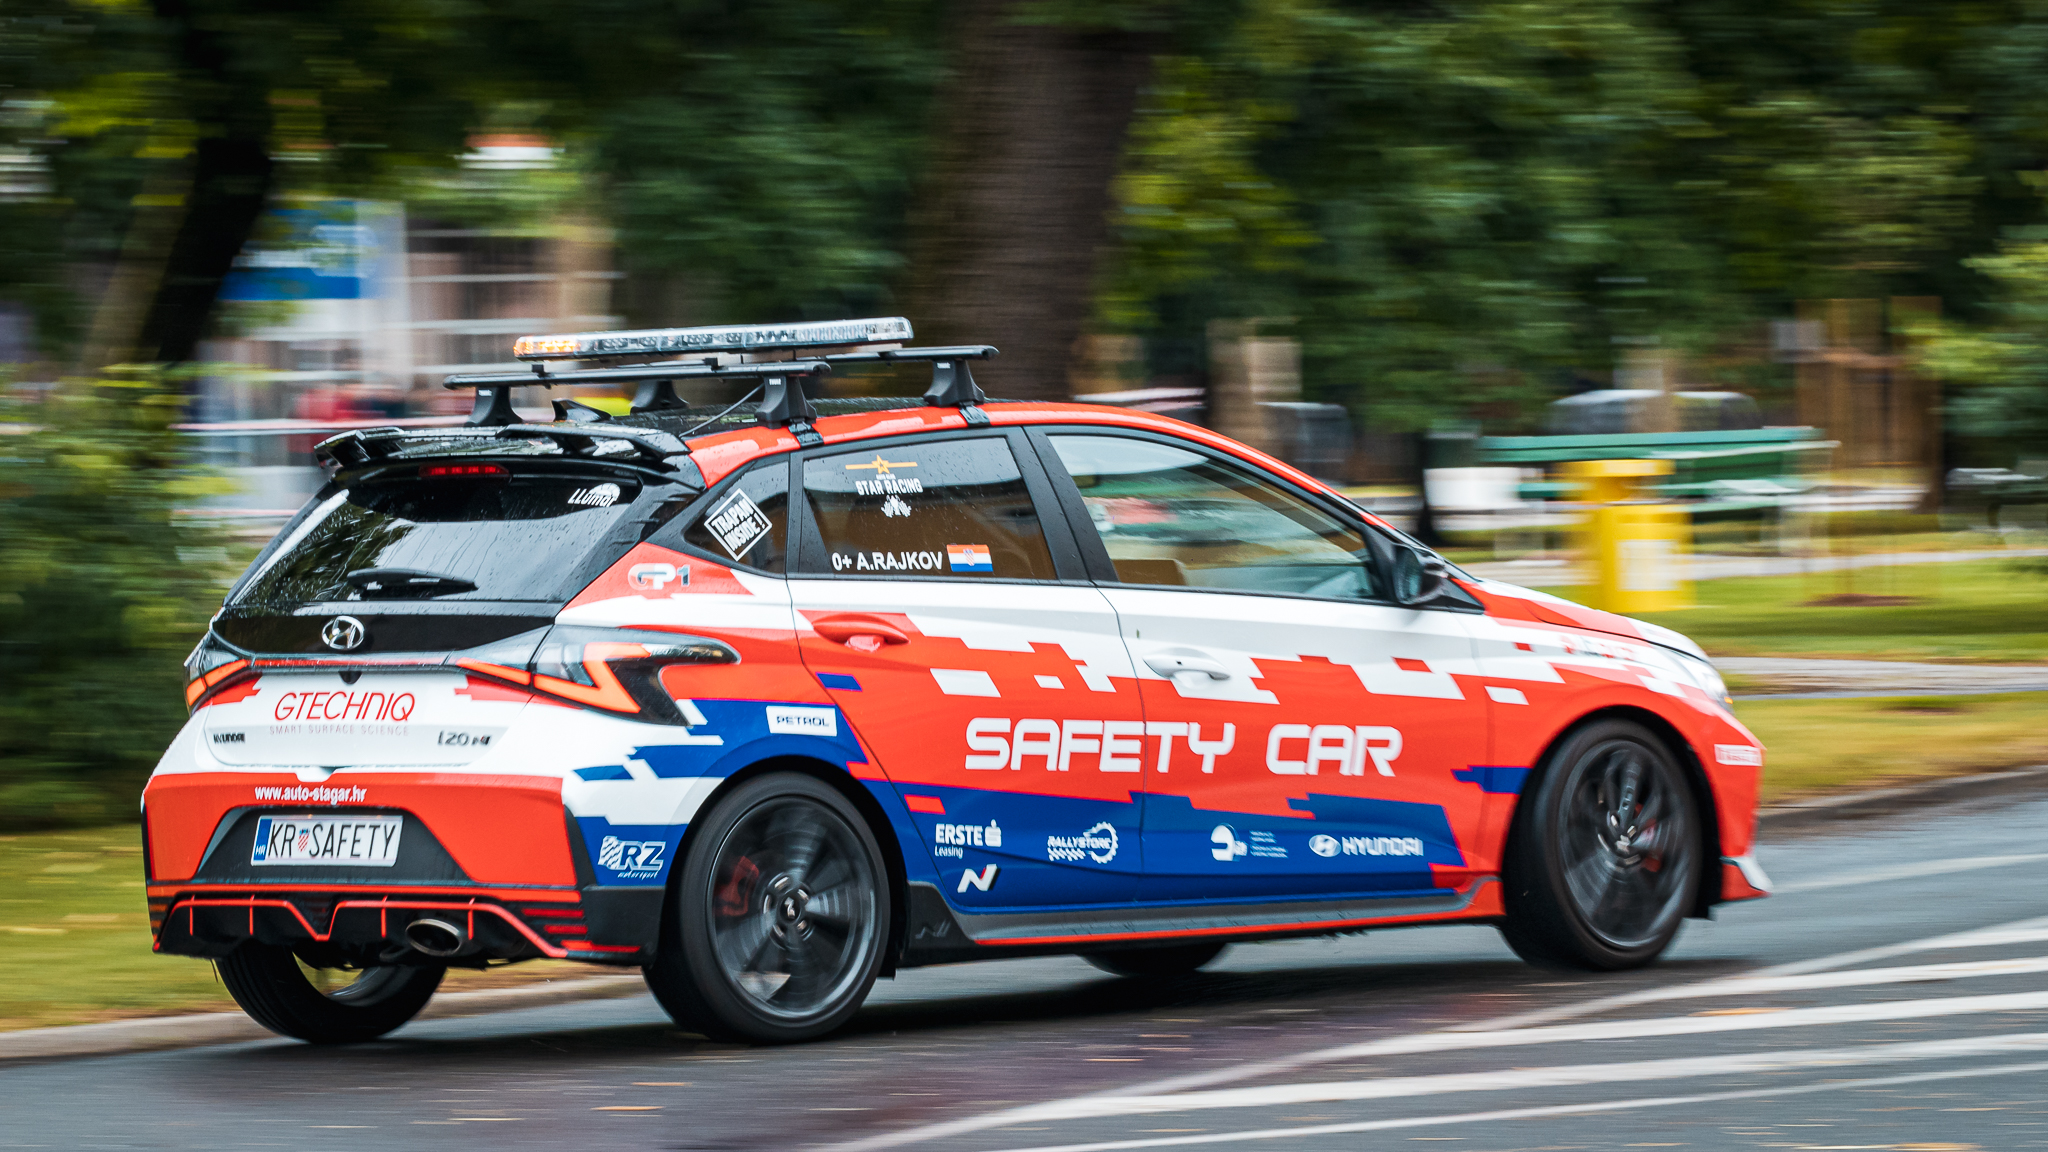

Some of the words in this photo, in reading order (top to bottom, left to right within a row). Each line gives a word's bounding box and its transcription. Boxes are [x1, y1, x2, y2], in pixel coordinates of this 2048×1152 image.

[855, 480, 885, 496] STAR
[886, 478, 924, 494] RACING
[710, 498, 754, 537] TRAPAN
[831, 552, 852, 571] 0+
[856, 551, 943, 571] A.RAJKOV
[274, 690, 416, 721] GTECHNIQ
[269, 724, 302, 736] SMART
[308, 724, 355, 735] SURFACE
[360, 725, 410, 737] SCIENCE
[776, 715, 830, 728] PETROL
[965, 716, 1237, 774] SAFETY
[1265, 723, 1403, 777] CAR
[254, 784, 367, 805] www.auto-stagar.hr
[268, 823, 297, 858] KR
[309, 823, 397, 859] SAFETY
[935, 823, 984, 847] ERSTE
[619, 840, 667, 871] RZ
[934, 845, 964, 860] Leasing
[1341, 836, 1425, 857] HYUNDAI
